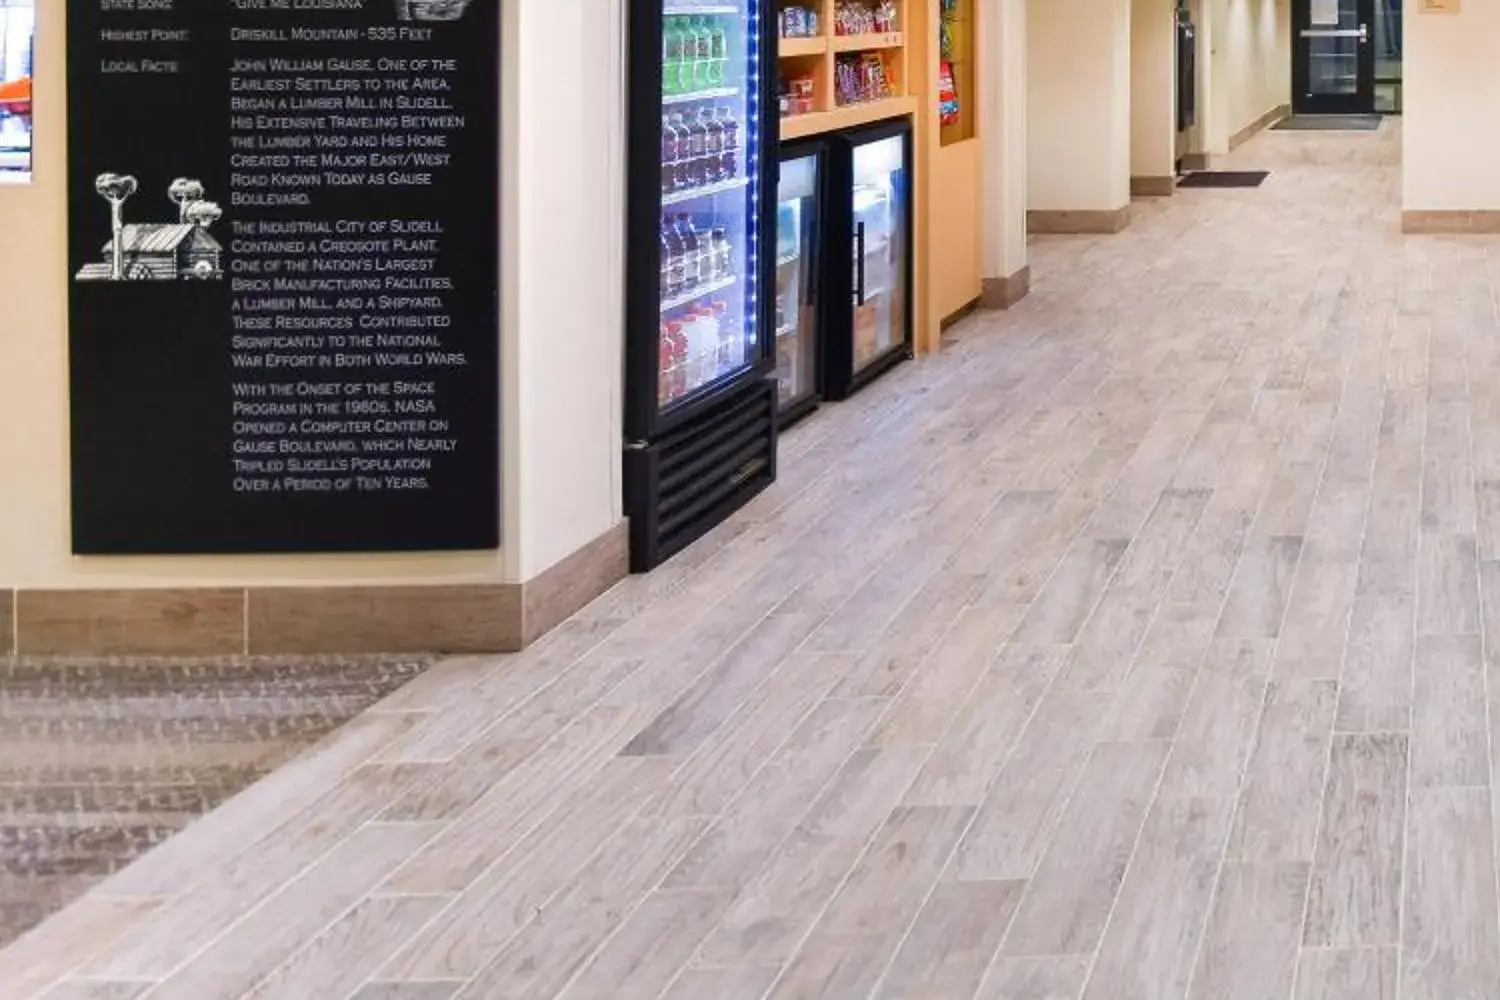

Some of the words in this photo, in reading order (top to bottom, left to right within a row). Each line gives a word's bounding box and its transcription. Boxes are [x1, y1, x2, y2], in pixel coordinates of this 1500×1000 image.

[378, 57, 406, 72] ONE
[410, 59, 428, 72] OF
[432, 59, 456, 72] THE
[365, 79, 380, 92] TO
[385, 79, 408, 92] THE
[380, 98, 393, 110] IN
[230, 115, 252, 129] HIS
[231, 137, 254, 149] THE
[351, 137, 377, 149] AND
[381, 135, 404, 149] HIS
[294, 155, 317, 167] THE
[368, 173, 384, 187] AS
[232, 221, 255, 234] THE
[369, 221, 386, 234] OF
[230, 258, 260, 272] ONE
[264, 260, 280, 272] OF
[285, 260, 308, 272] THE
[336, 297, 363, 311] AND
[329, 336, 345, 349] TO
[349, 336, 373, 349] THE
[231, 353, 262, 368] WAR
[319, 355, 331, 368] IN
[270, 383, 293, 396] THE
[344, 383, 362, 396] OF
[366, 383, 389, 396] THE
[300, 402, 312, 415] IN
[316, 402, 339, 415] THE
[429, 421, 448, 434] ON
[335, 478, 351, 492] OF
